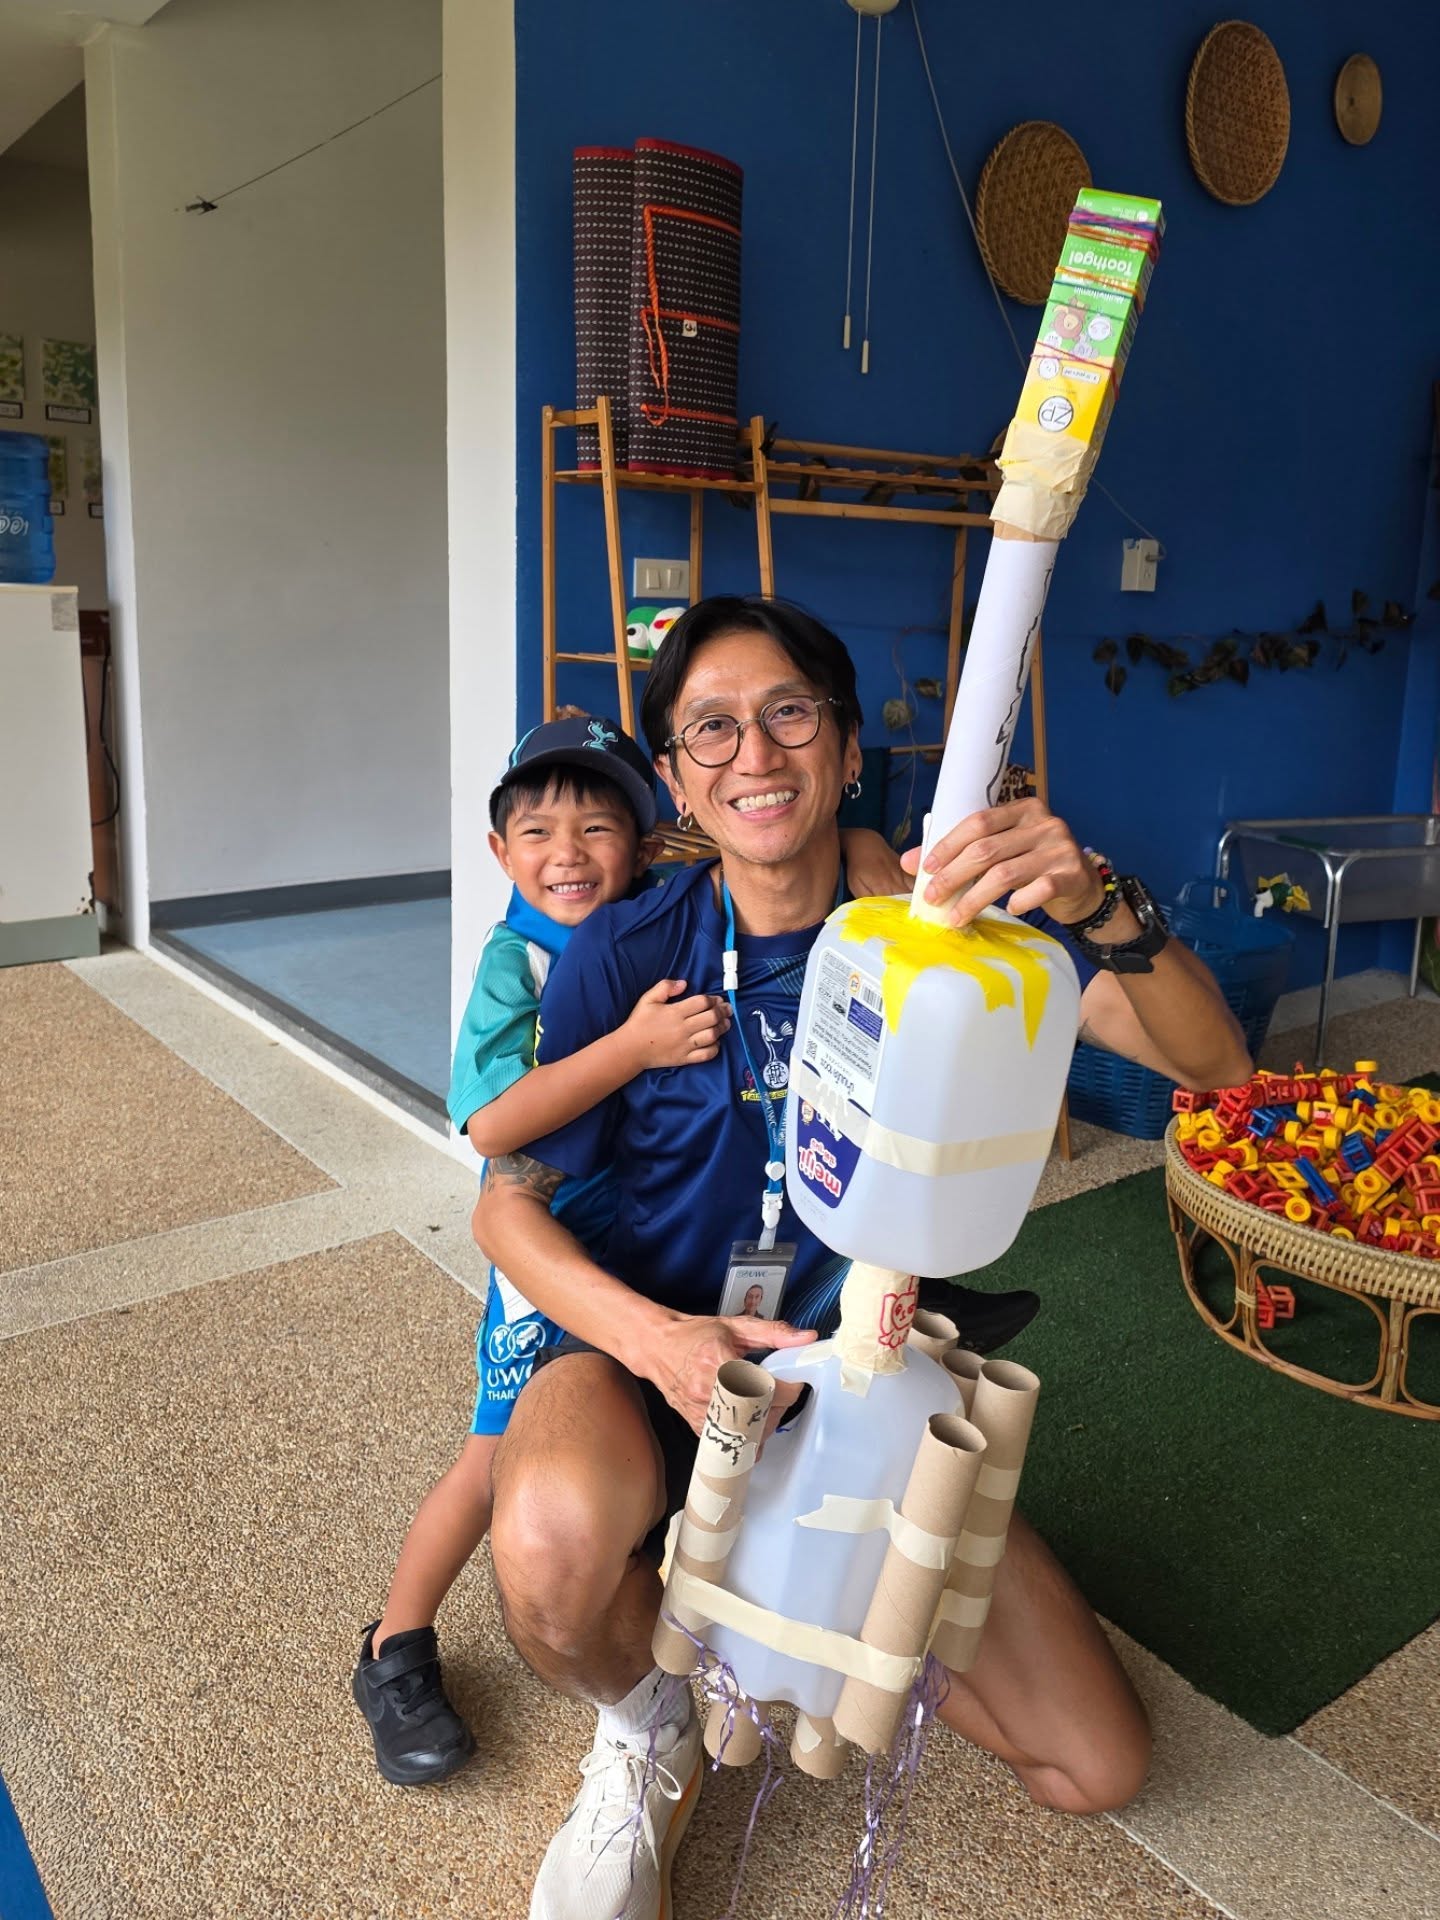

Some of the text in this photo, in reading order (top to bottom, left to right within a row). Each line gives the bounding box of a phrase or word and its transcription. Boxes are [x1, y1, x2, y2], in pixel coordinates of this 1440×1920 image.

[1069, 251, 1133, 277] Toothgel
[1041, 406, 1073, 425] ZP
[799, 1148, 842, 1198] meiji
[487, 1388, 521, 1401] THAIL
